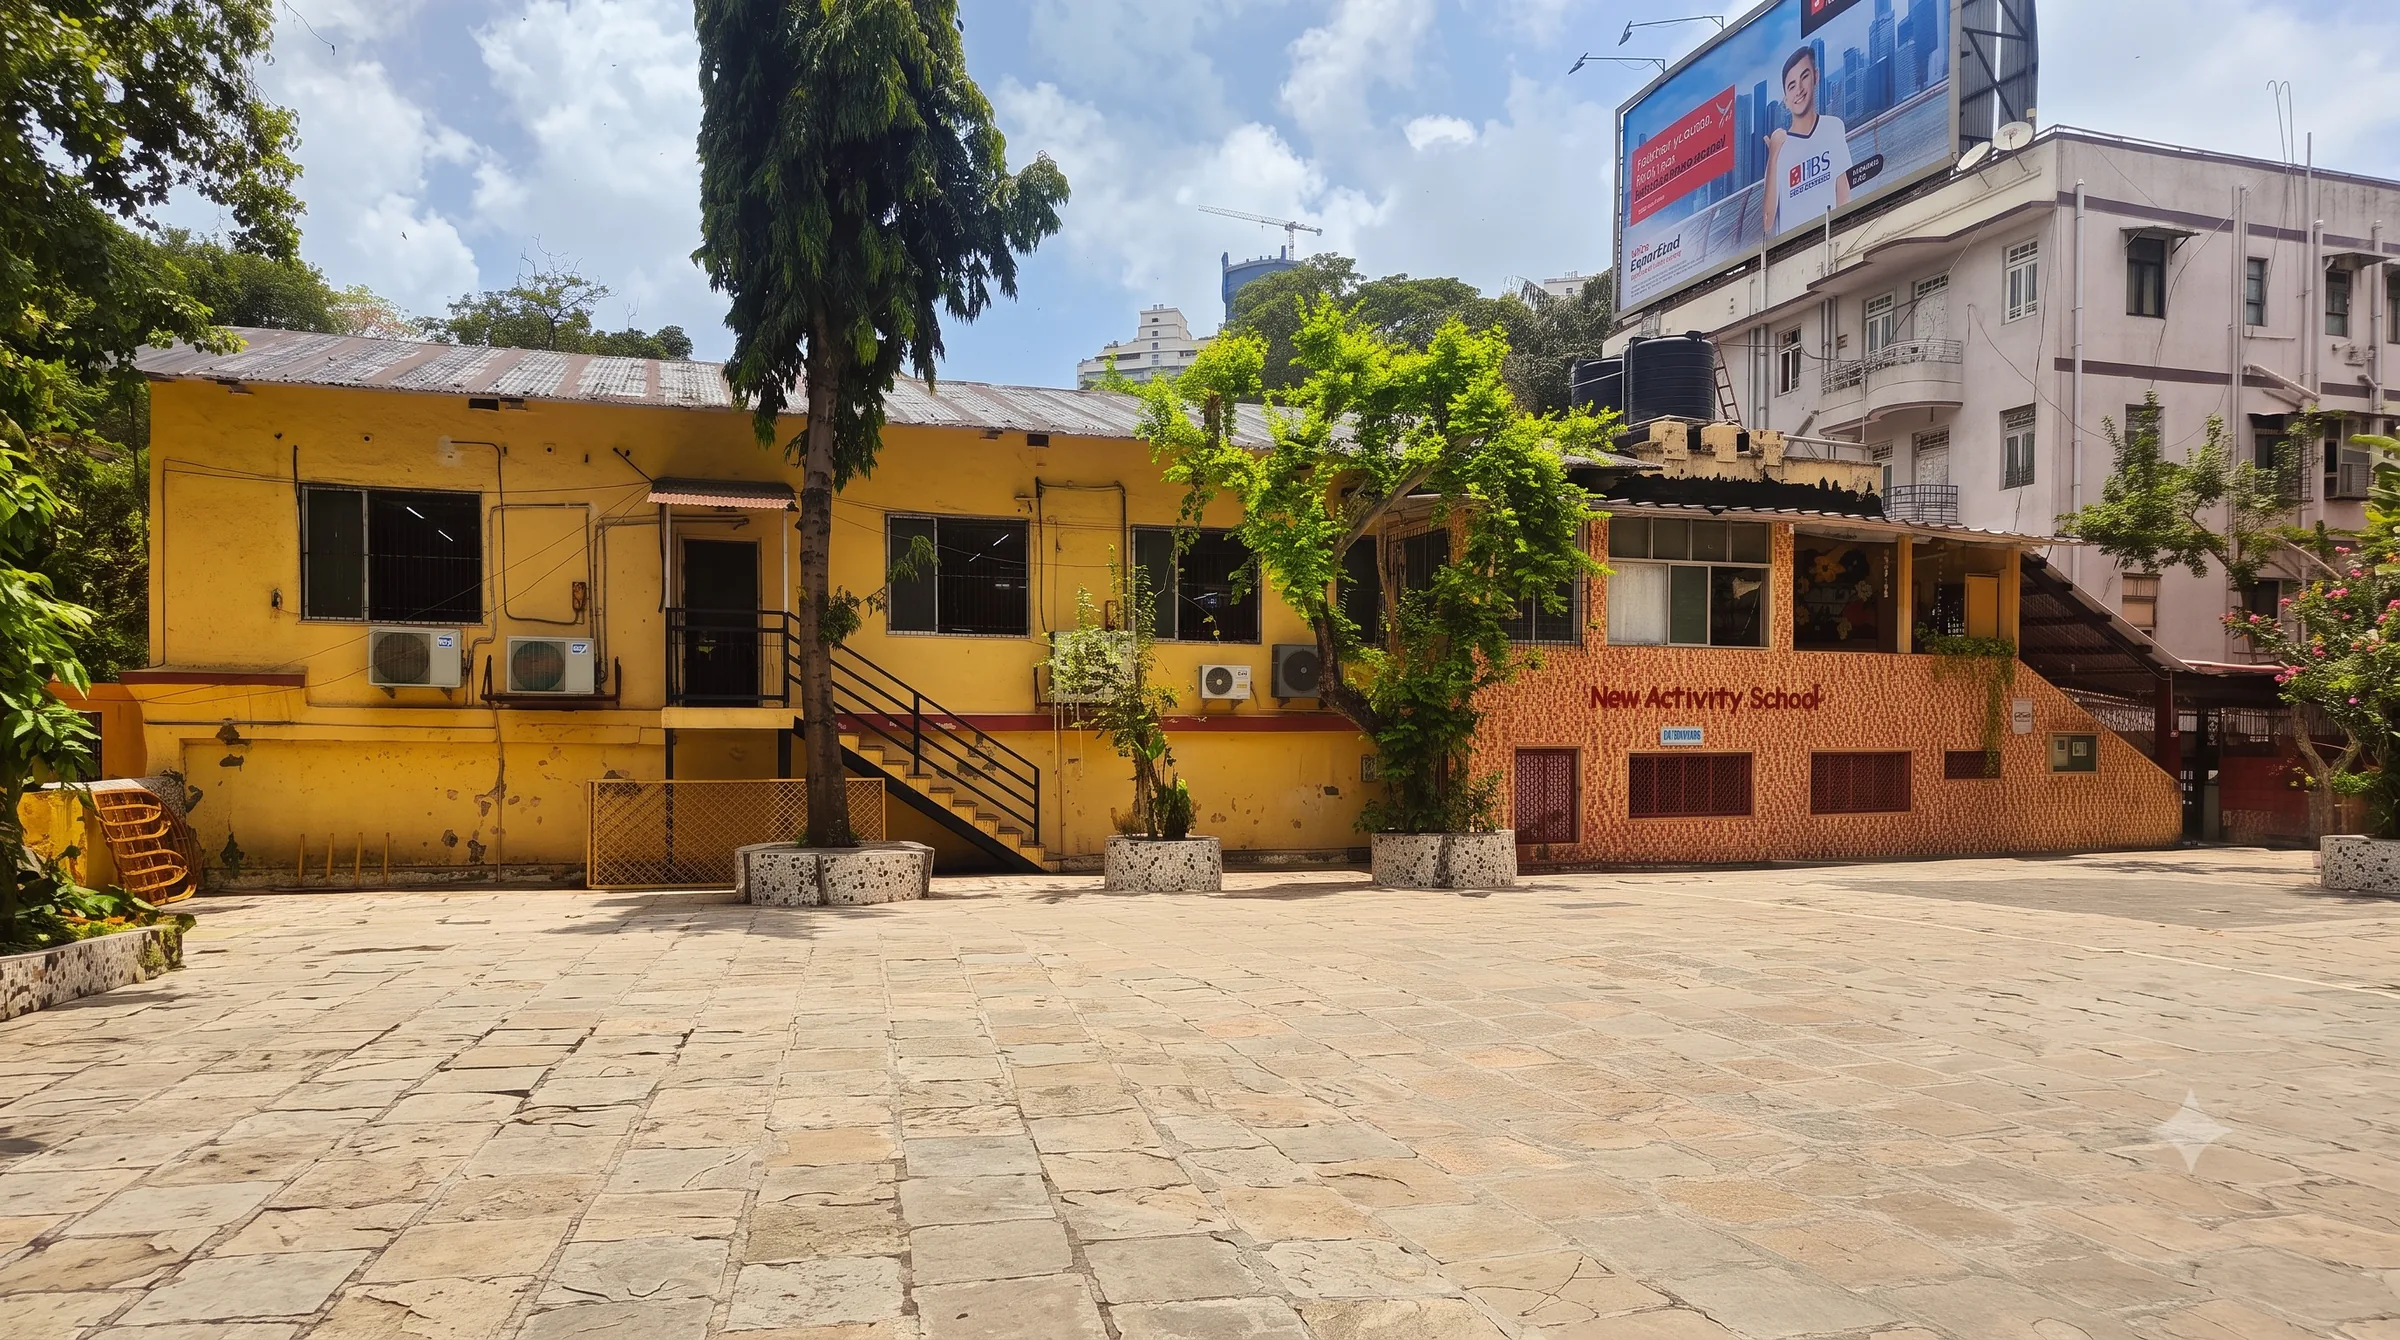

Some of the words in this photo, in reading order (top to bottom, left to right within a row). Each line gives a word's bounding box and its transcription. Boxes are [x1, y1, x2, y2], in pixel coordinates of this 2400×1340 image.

[1590, 685, 1640, 709] New
[1644, 686, 1744, 714] Activity
[1750, 685, 1821, 710] School
